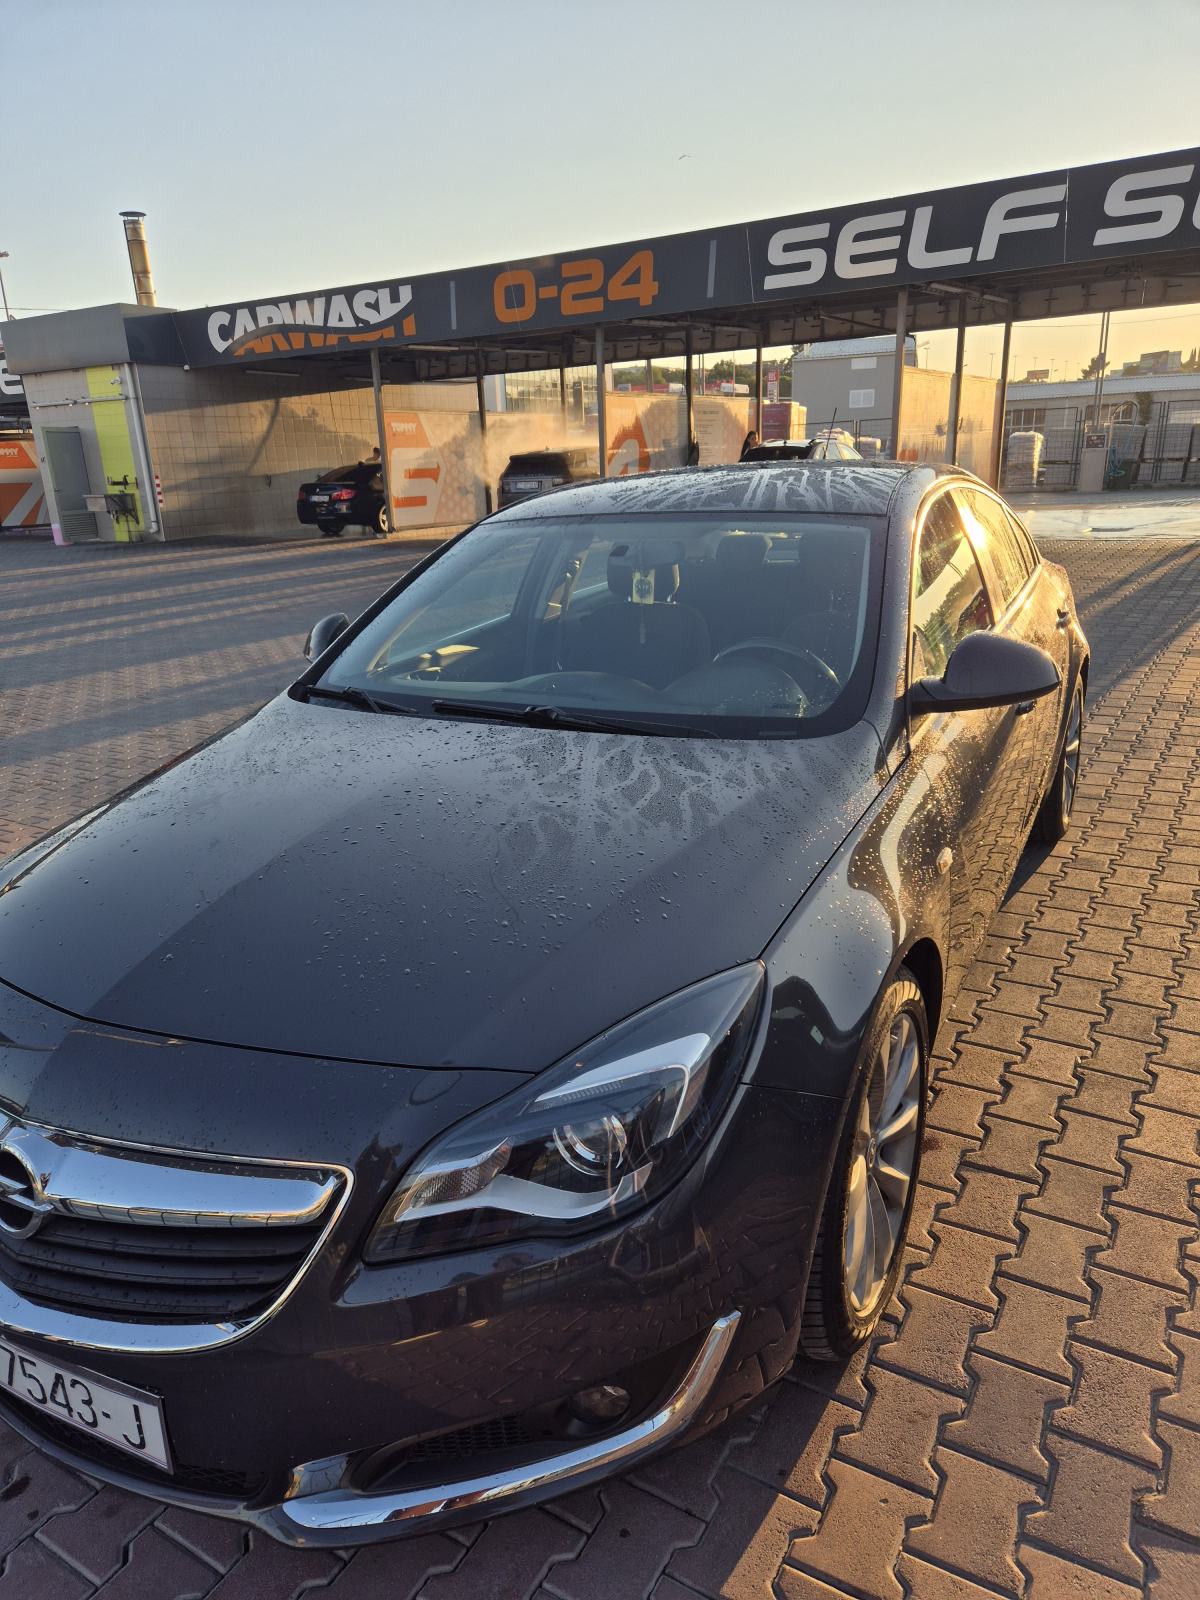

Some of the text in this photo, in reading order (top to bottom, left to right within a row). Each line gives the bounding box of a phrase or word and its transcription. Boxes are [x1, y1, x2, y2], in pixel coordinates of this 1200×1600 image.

[208, 164, 1200, 358] CARWASH 0-24 SELF S
